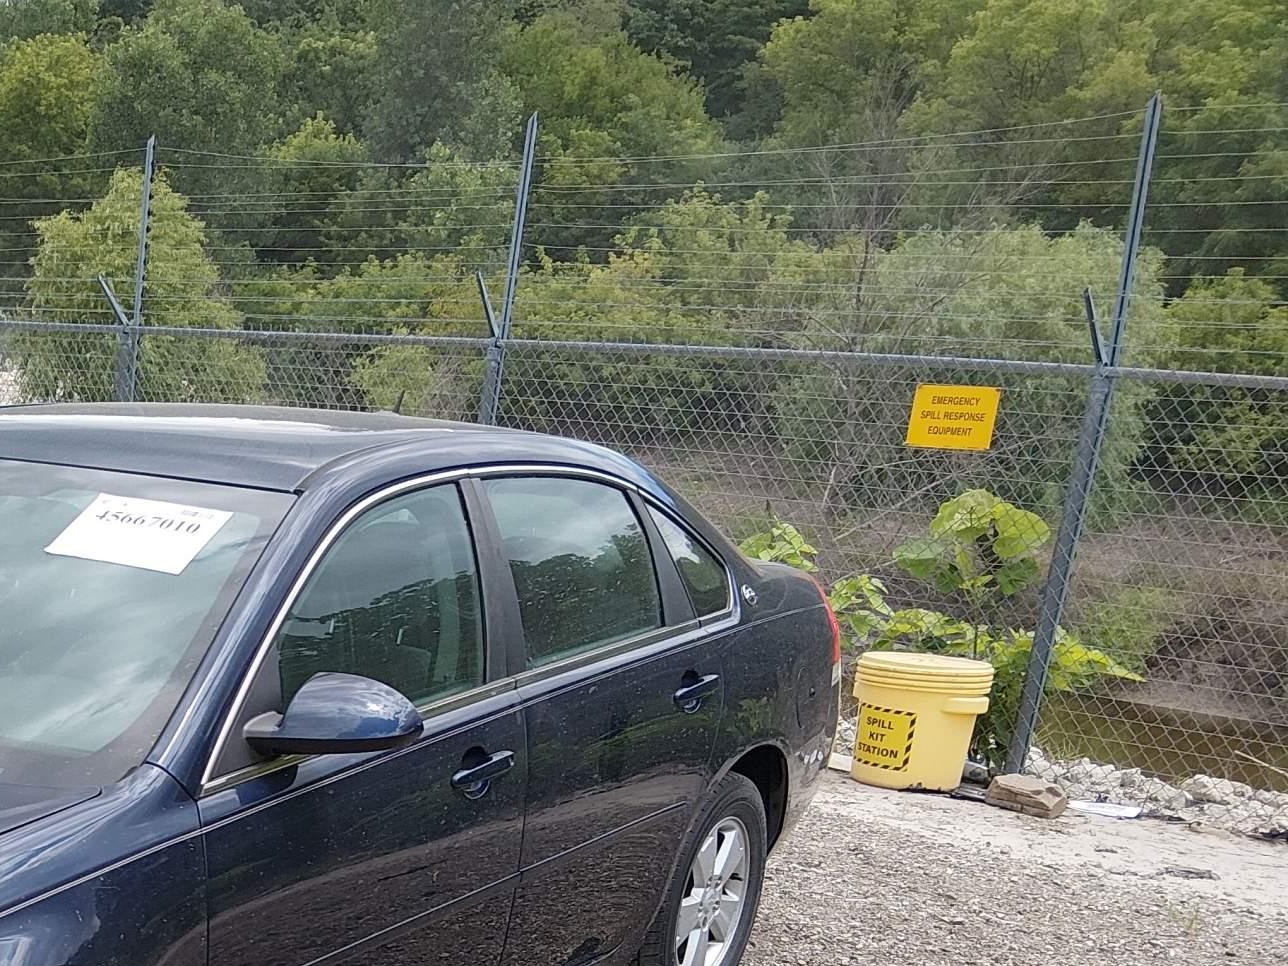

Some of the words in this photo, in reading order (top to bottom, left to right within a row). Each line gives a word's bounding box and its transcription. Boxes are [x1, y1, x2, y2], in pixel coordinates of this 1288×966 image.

[931, 395, 981, 407] EMERGENCY
[920, 410, 942, 420] SPILL
[943, 411, 986, 422] RESPONSE
[927, 425, 973, 437] EQUIPMENT
[95, 509, 202, 534] 45667010
[866, 716, 894, 730] SPILL
[868, 731, 886, 742] KIT
[857, 742, 899, 758] STATION
